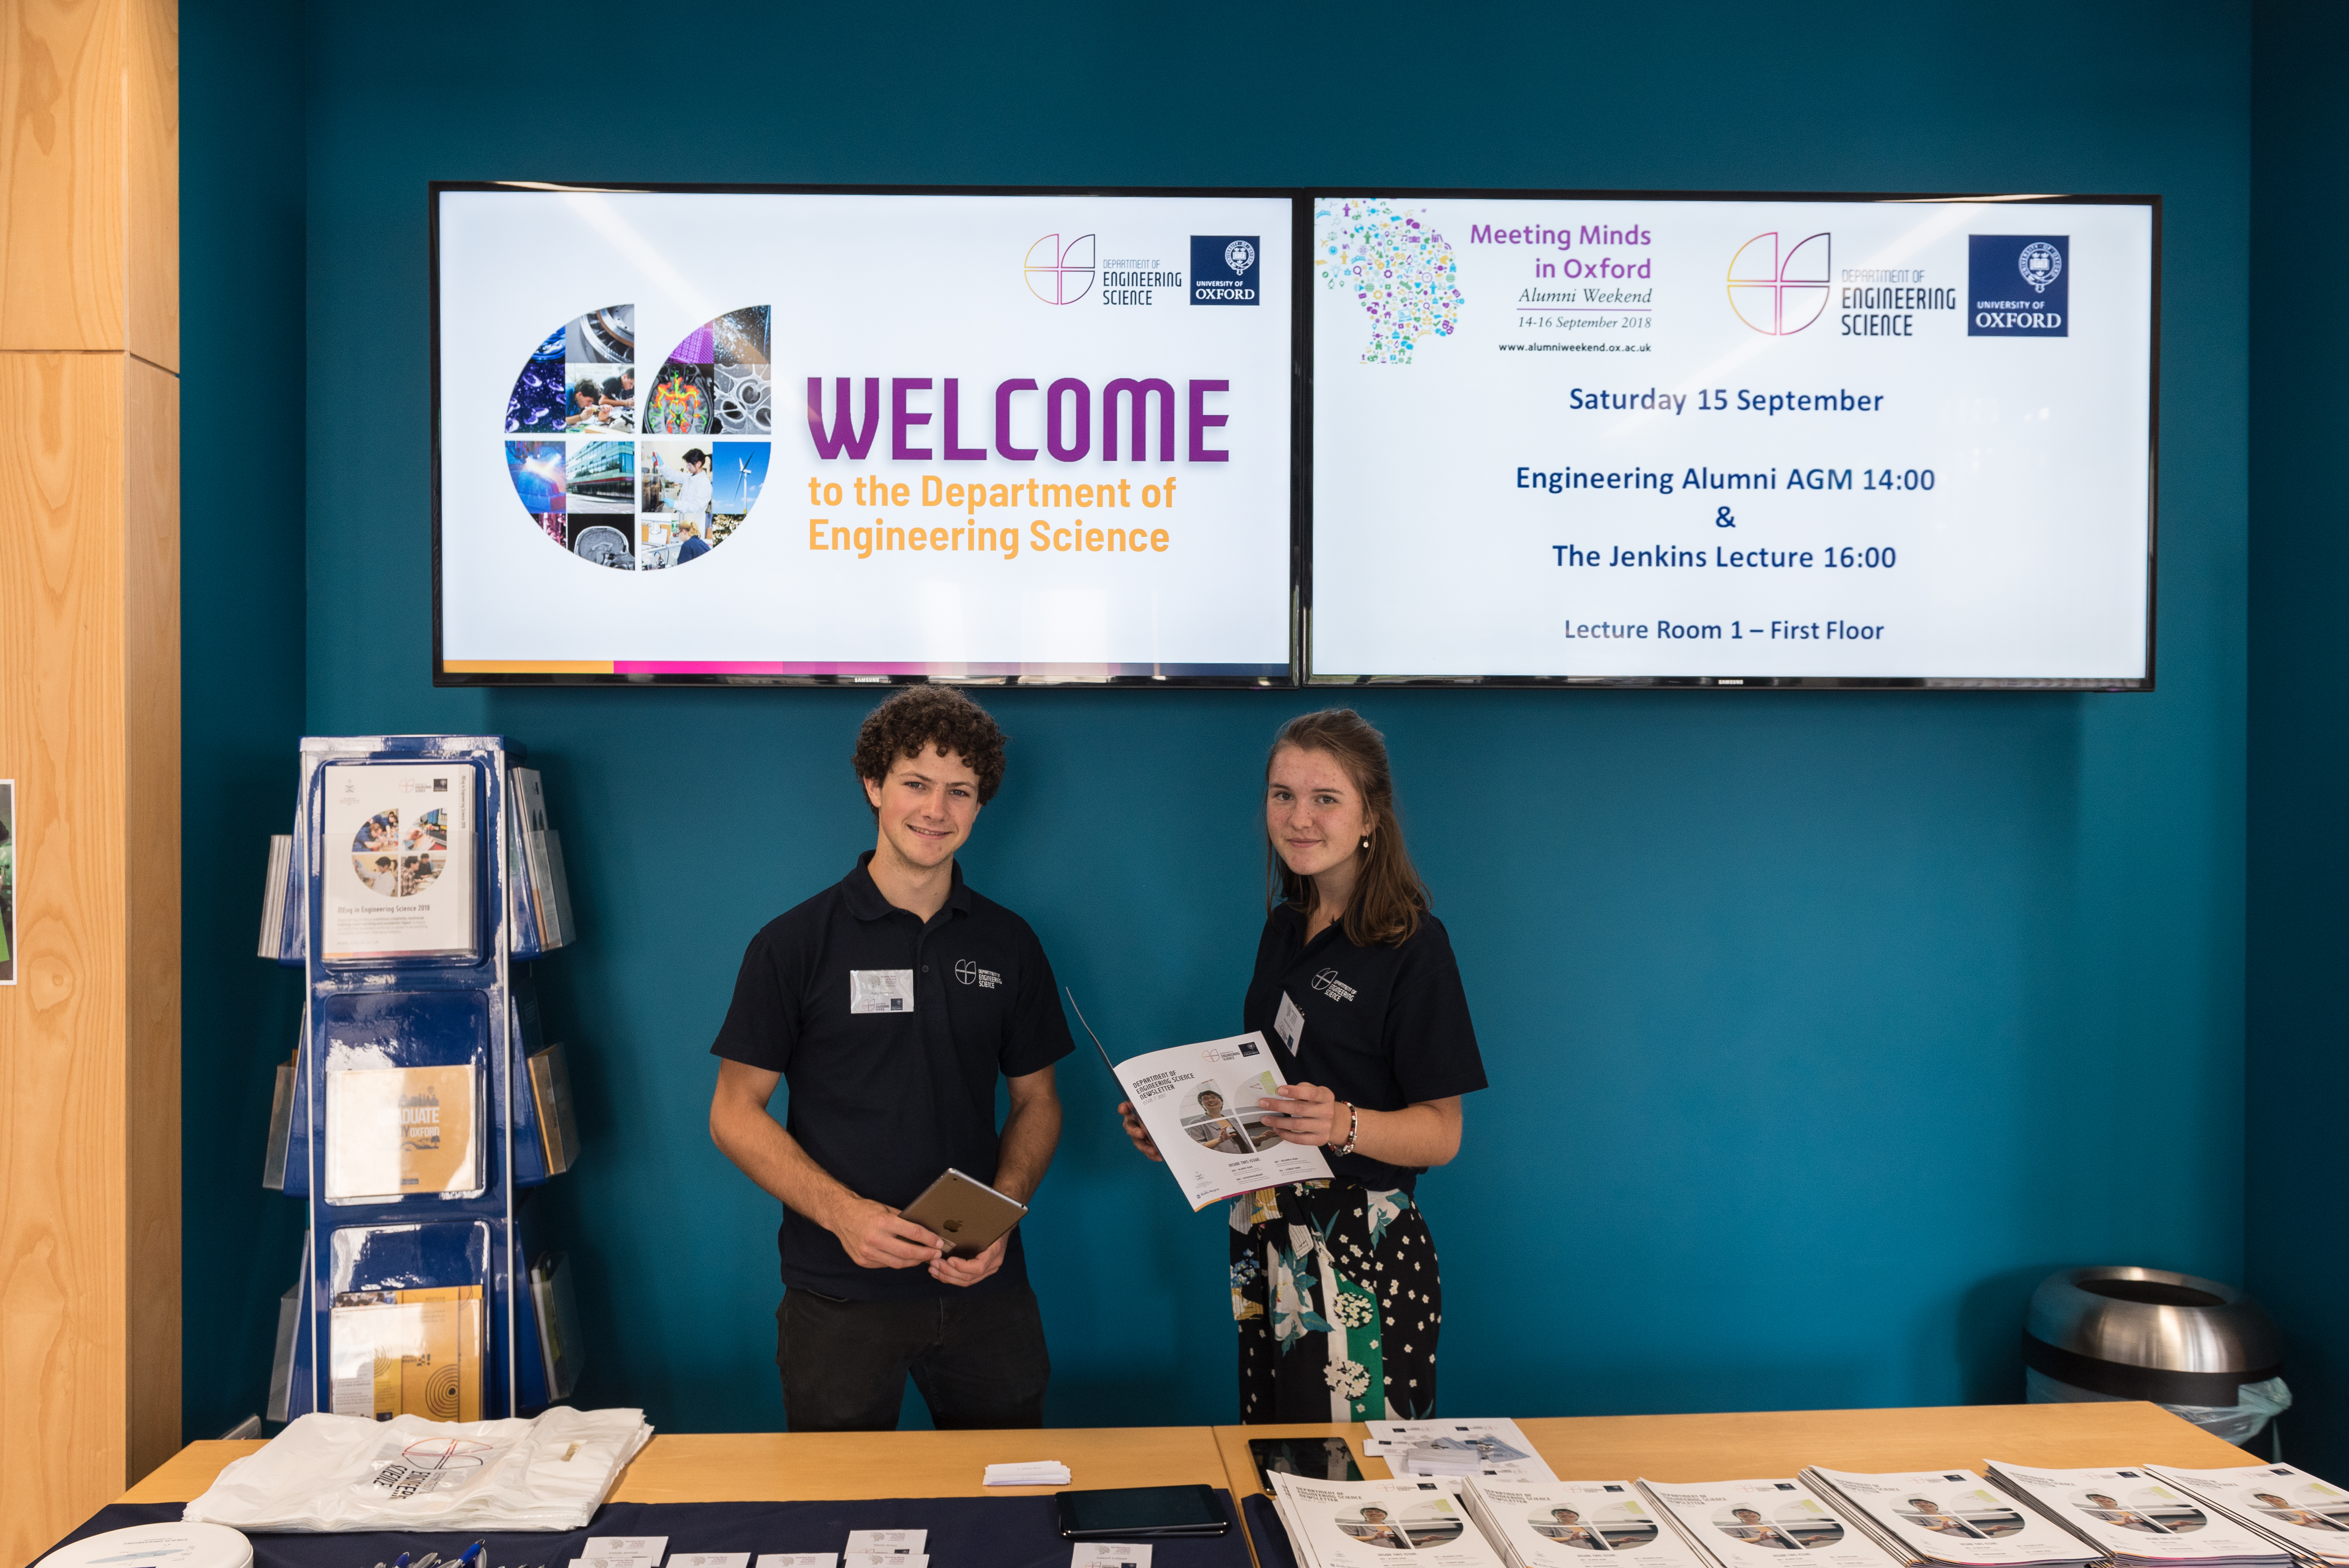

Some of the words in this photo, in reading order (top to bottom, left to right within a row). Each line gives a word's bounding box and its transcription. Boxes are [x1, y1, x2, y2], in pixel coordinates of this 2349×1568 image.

[1470, 224, 1571, 250] Meeting
[1579, 224, 1652, 246] Minds
[1103, 259, 1150, 269] DEPARTMENT
[1151, 260, 1160, 269] OF
[1535, 258, 1556, 278] in
[1564, 258, 1651, 279] Oxford
[1103, 271, 1182, 287] ENGINEERING
[1842, 269, 1910, 282] DEPARTMENT
[1912, 270, 1925, 282] OF
[1103, 290, 1153, 305] SCIENCE
[1195, 288, 1255, 300] OXFORD
[1518, 288, 1576, 303] Alumni
[1583, 288, 1652, 303] Weekend
[1842, 287, 1956, 310] ENGINEERING
[1977, 301, 2030, 310] UNIVERSITY
[2032, 301, 2045, 310] OF
[1518, 316, 1552, 328] 14-16
[1556, 316, 1618, 330] September
[1621, 317, 1652, 328] 2018
[1841, 314, 1913, 336] SCIENCE
[1975, 312, 2061, 328] OXFORD
[1499, 342, 1652, 353] www.alumniweekend.ox.ac.uk
[1569, 388, 1687, 415] Saturday
[1698, 389, 1728, 411] 15
[1737, 388, 1884, 416] September
[807, 377, 1229, 462] WELCOME
[1517, 467, 1674, 495] Engineering
[1682, 468, 1777, 490] Alumni
[1786, 469, 1853, 490] AGM
[1863, 469, 1935, 491] 14:00
[808, 477, 843, 506] to
[854, 475, 910, 506] the
[921, 475, 1130, 515] Department
[1141, 477, 1176, 508] of
[1715, 505, 1736, 529] &
[809, 517, 1019, 560] Engineering
[1030, 519, 1170, 552] Science
[1553, 544, 1601, 567] The
[1609, 545, 1707, 568] Jenkins
[1716, 545, 1813, 568] Lecture
[1824, 546, 1896, 569] 16:00
[1565, 619, 1648, 640] Lecture
[1657, 620, 1722, 640] Room
[1731, 622, 1743, 640] 1
[1771, 621, 1821, 641] First
[1827, 620, 1884, 641] Floor
[361, 905, 394, 914] Engineering
[396, 905, 417, 913] Science
[978, 974, 1002, 984] ENGINEERING
[979, 980, 994, 989] SCIENCE
[1324, 989, 1342, 1002] SCIENCE
[1329, 984, 1355, 1001] ENGINEERING
[1132, 1072, 1168, 1089] DEPARTMENT
[1136, 1078, 1172, 1094] ENGINEERING
[1172, 1073, 1195, 1083] SCIENCE
[1140, 1084, 1175, 1100] NEWSLETTER
[410, 1126, 440, 1138] OXFORD
[373, 1464, 408, 1488] SCIENCE
[1296, 1486, 1336, 1495] DEPARTMENT
[1297, 1490, 1337, 1499] ENGINEERING
[1299, 1493, 1338, 1502] NEWSLETTER
